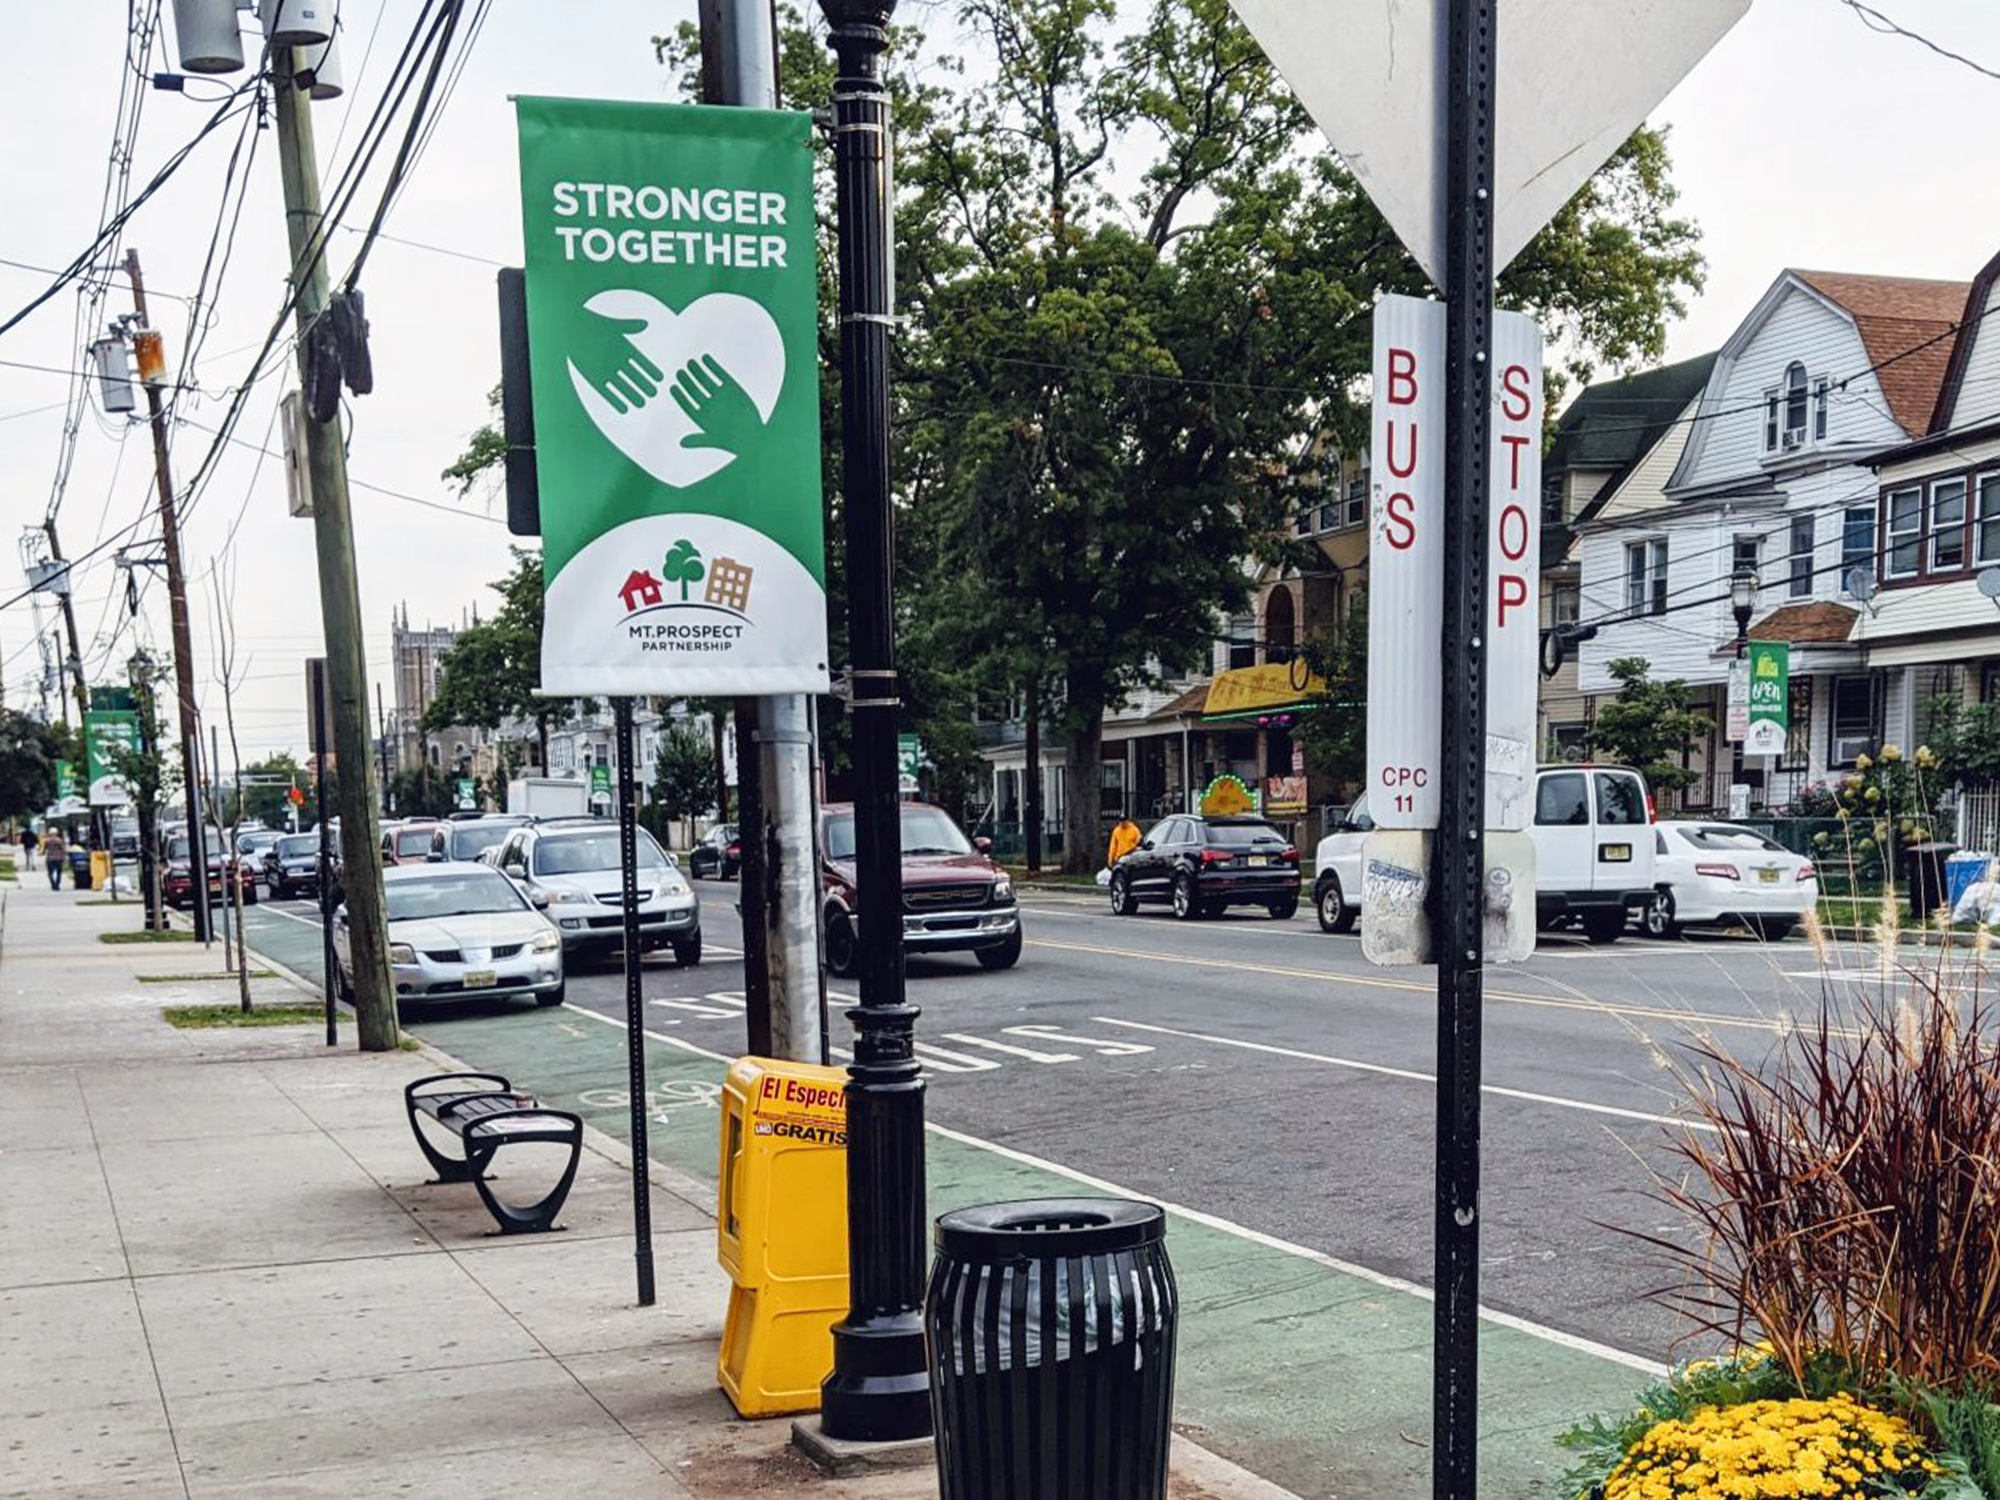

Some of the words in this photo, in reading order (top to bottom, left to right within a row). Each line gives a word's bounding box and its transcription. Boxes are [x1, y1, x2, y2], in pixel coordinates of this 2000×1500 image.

[553, 182, 787, 225] STRONGER
[555, 226, 787, 268] TOGETHER
[1386, 347, 1418, 550] BUS
[1498, 364, 1531, 628] STOP
[642, 641, 732, 652] PARTNERSHIP
[1382, 766, 1428, 788] CPC
[1394, 795, 1413, 813] 11
[763, 1077, 782, 1099] El
[774, 1122, 848, 1145] GRATIS
